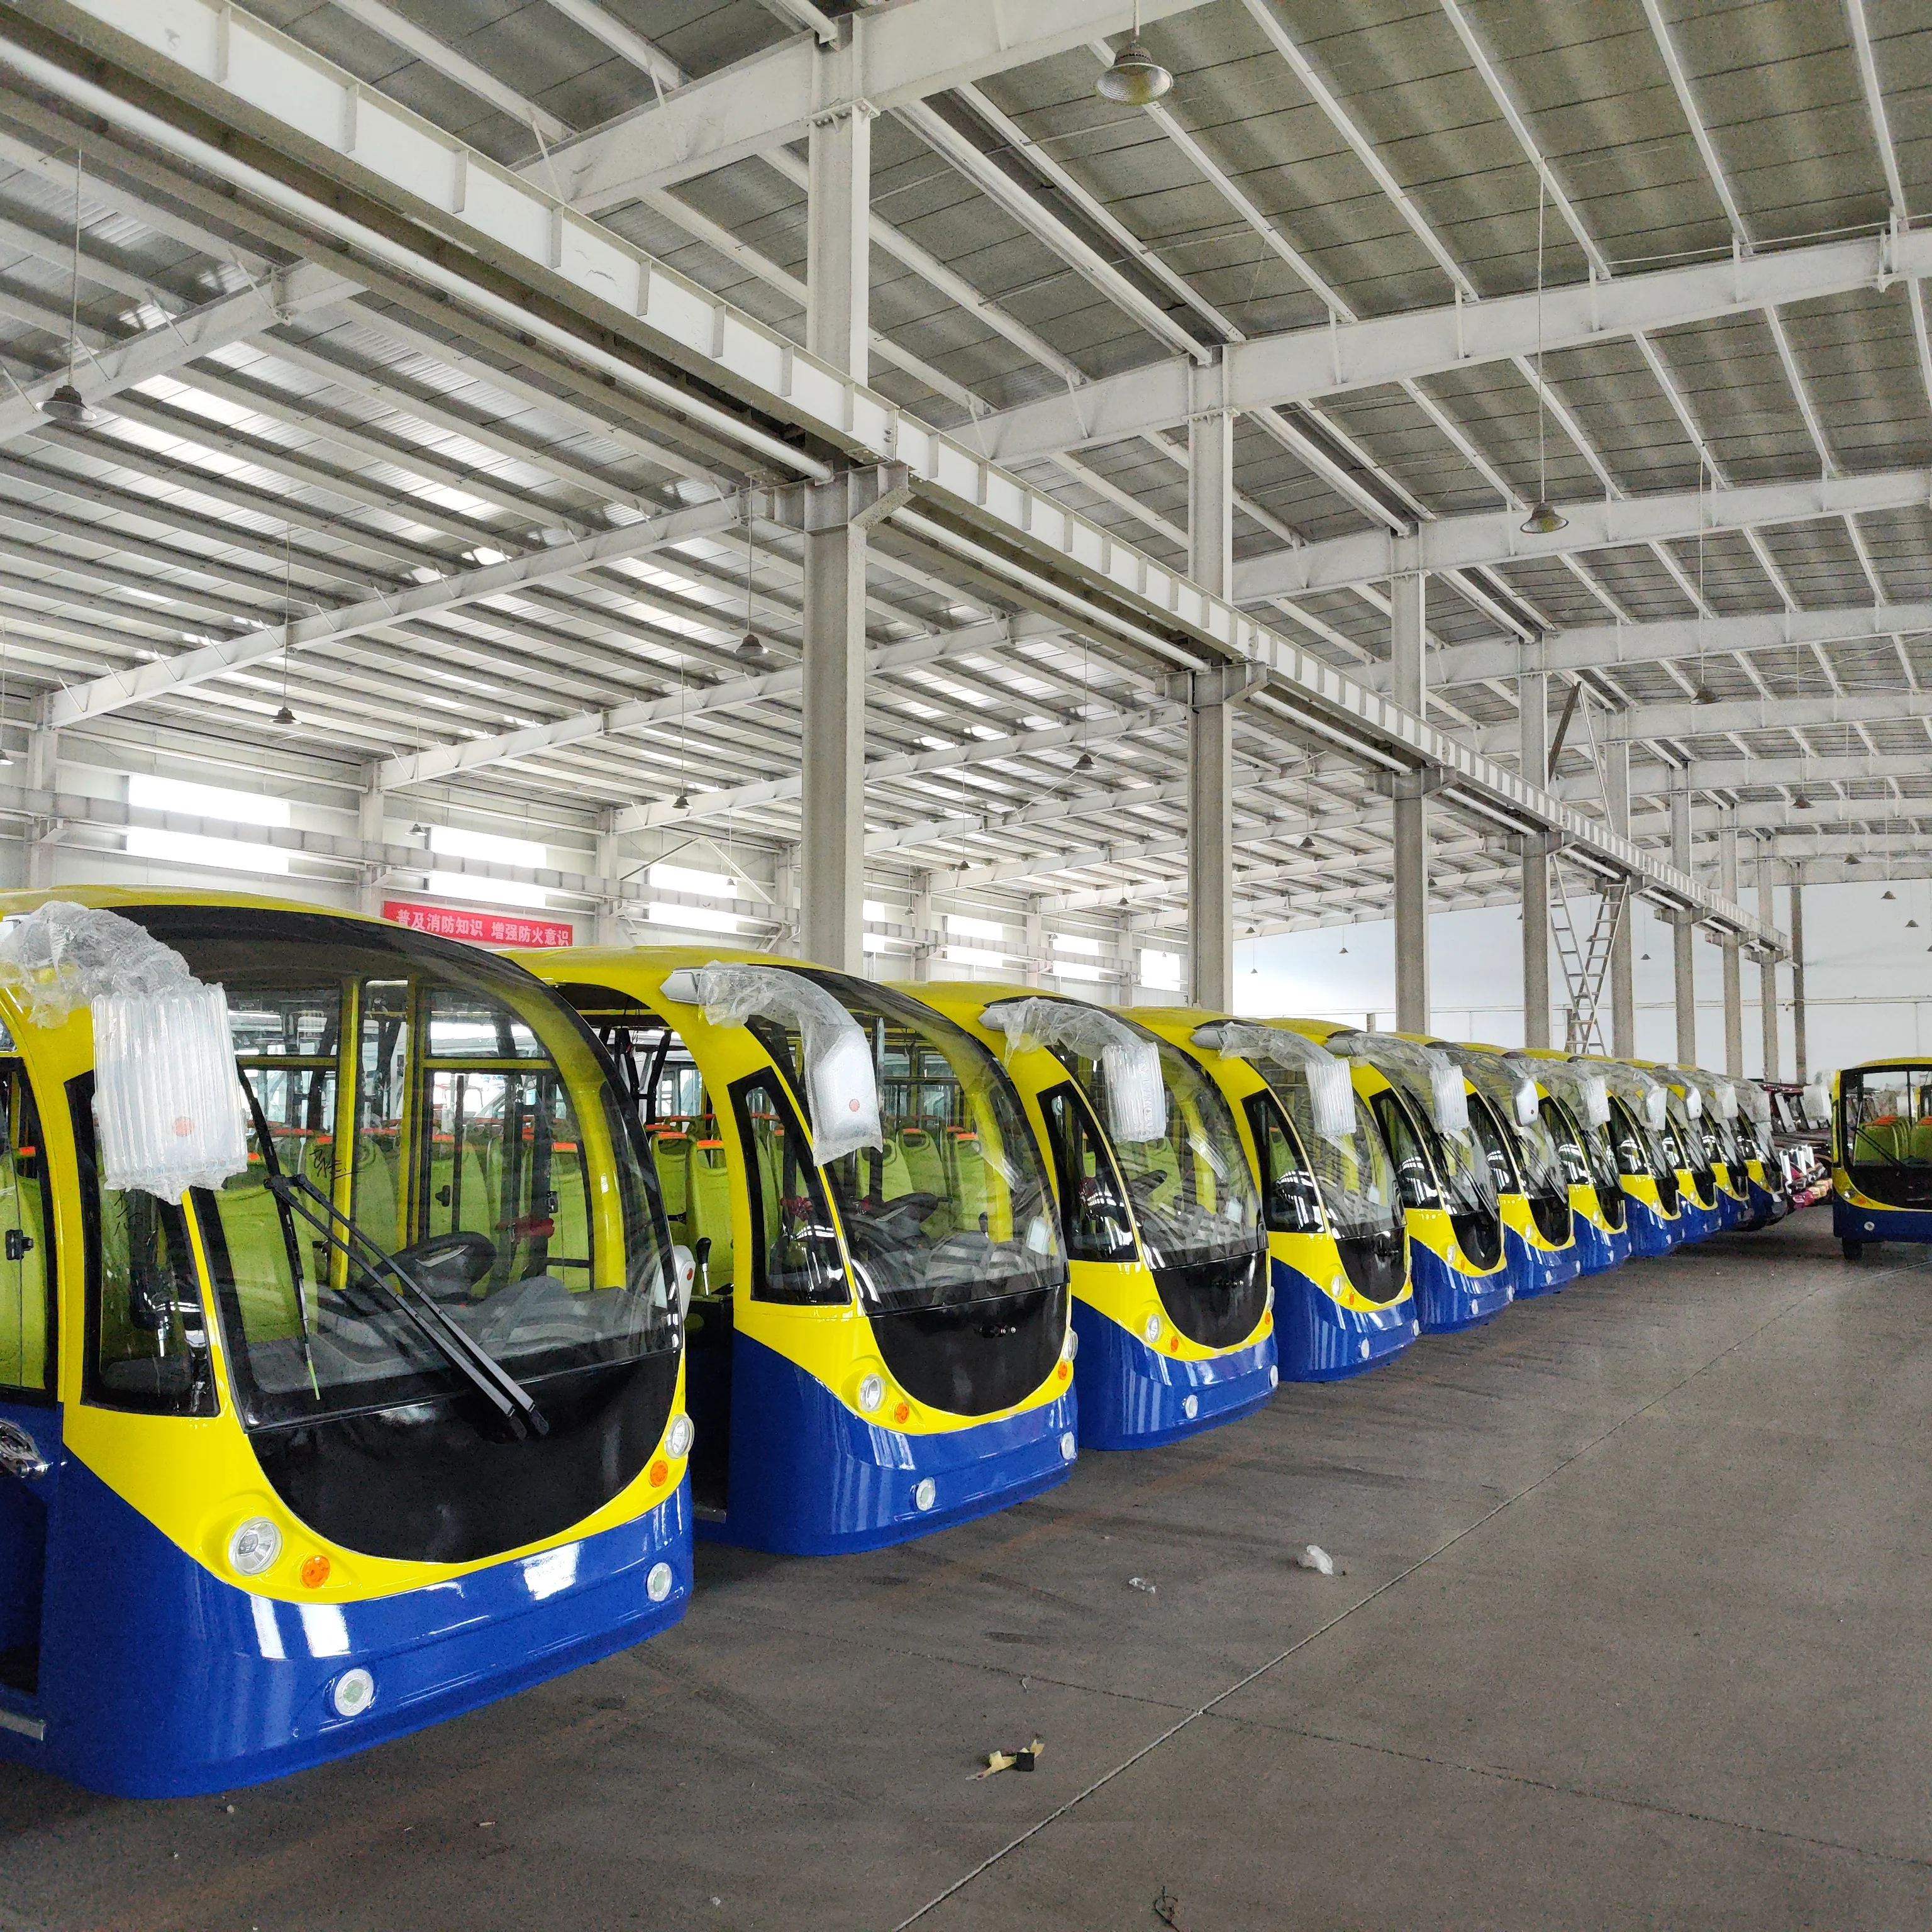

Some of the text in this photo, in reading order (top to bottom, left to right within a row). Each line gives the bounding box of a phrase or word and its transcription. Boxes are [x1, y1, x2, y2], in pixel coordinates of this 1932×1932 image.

[396, 909, 569, 947] 普及消防知识 增强防火意识
